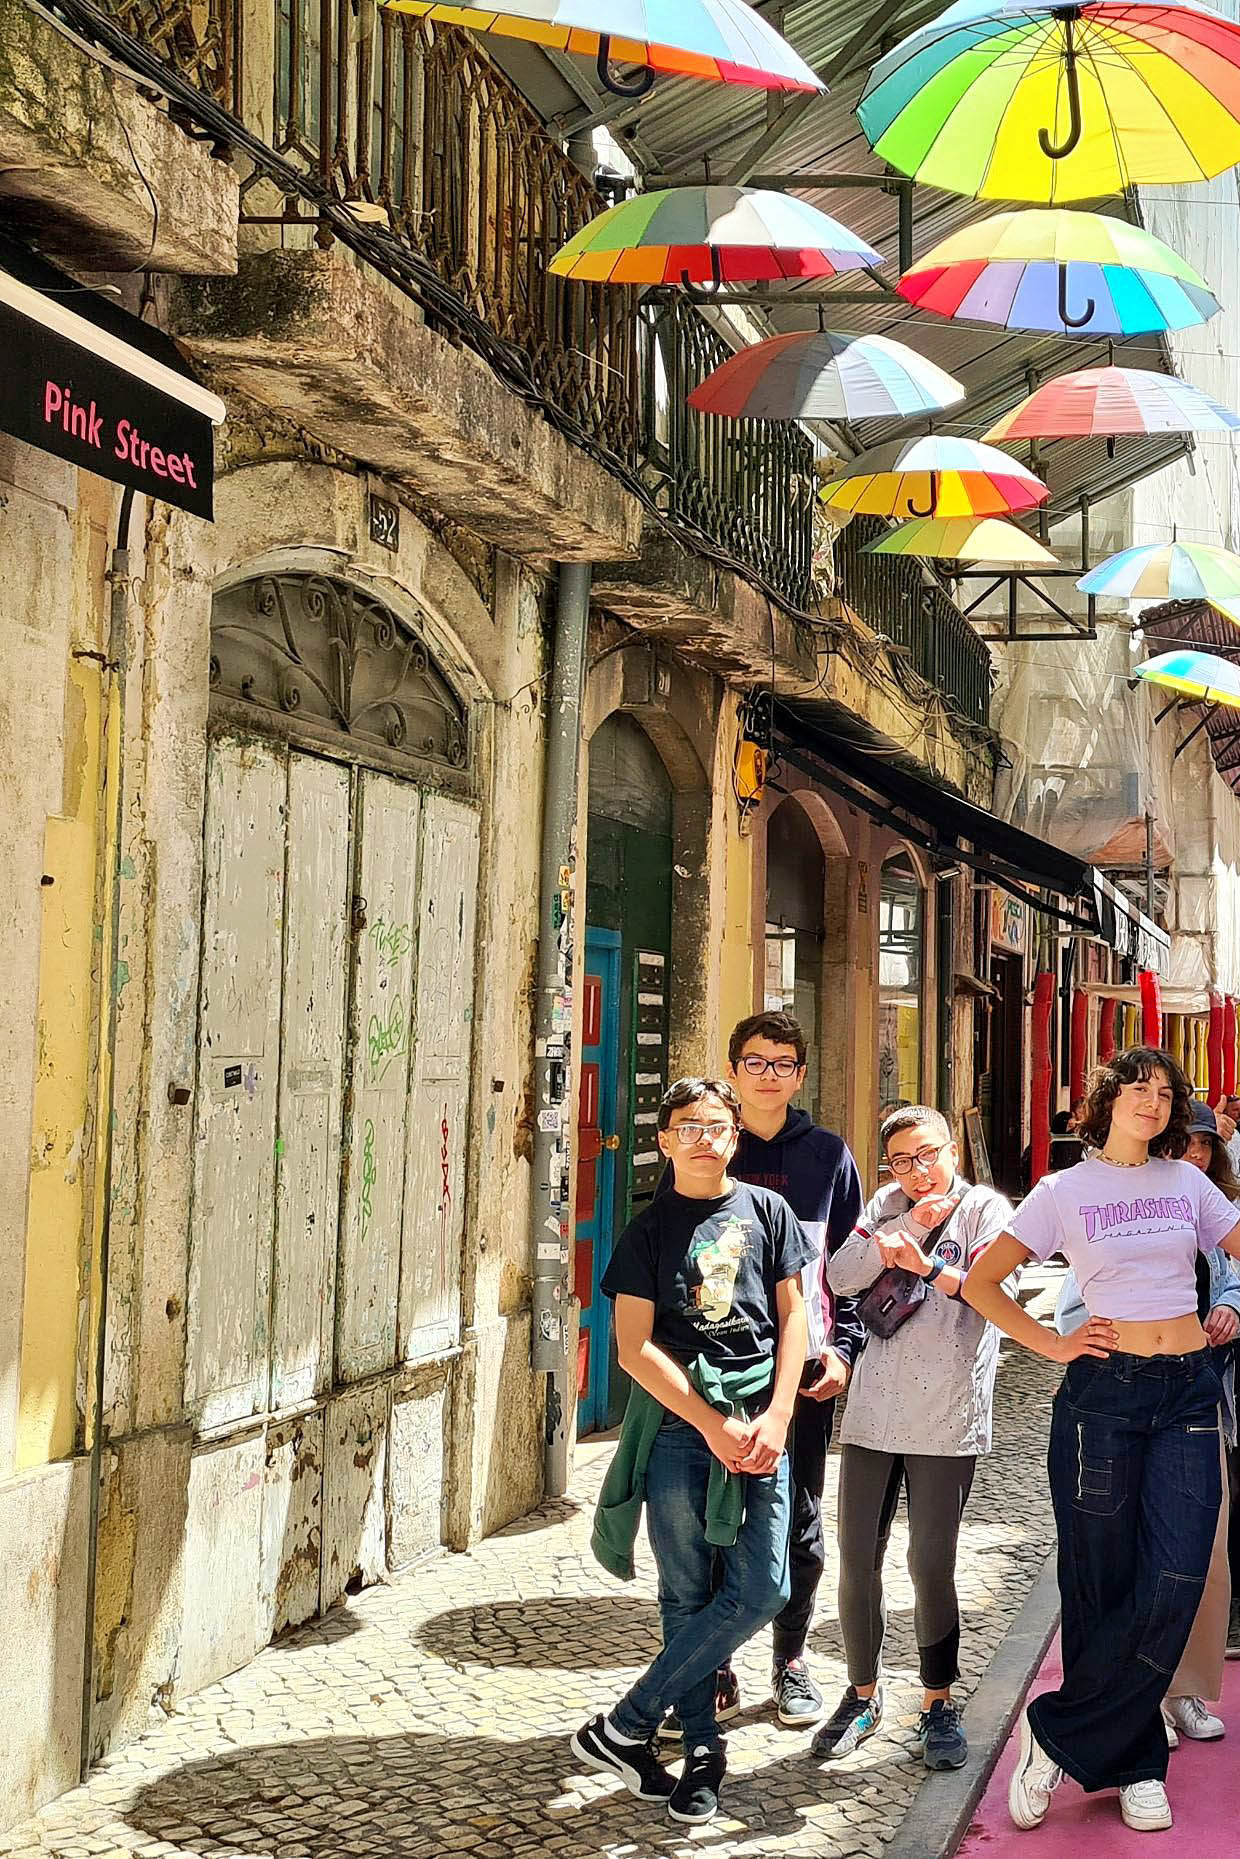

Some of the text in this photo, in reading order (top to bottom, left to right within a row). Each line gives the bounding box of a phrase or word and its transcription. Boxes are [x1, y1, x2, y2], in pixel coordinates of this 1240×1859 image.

[45, 380, 197, 489] Pink Street
[1079, 1195, 1194, 1241] THRASHER
